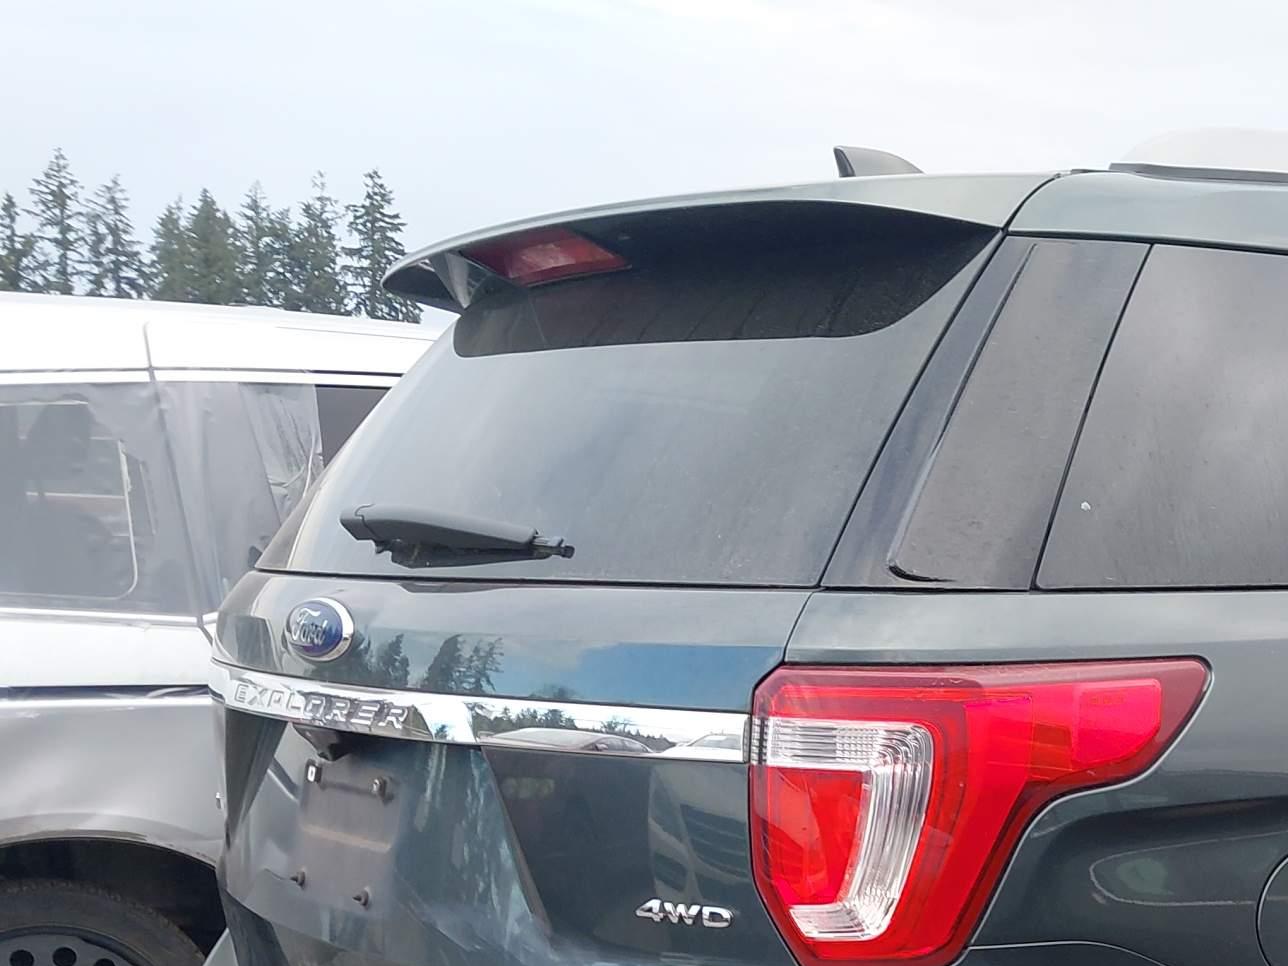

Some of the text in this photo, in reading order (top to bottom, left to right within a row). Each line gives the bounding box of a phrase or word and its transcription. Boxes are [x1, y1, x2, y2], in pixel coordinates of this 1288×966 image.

[290, 607, 329, 646] Ford
[234, 683, 409, 729] EXPLORER
[635, 898, 734, 928] 4WD
